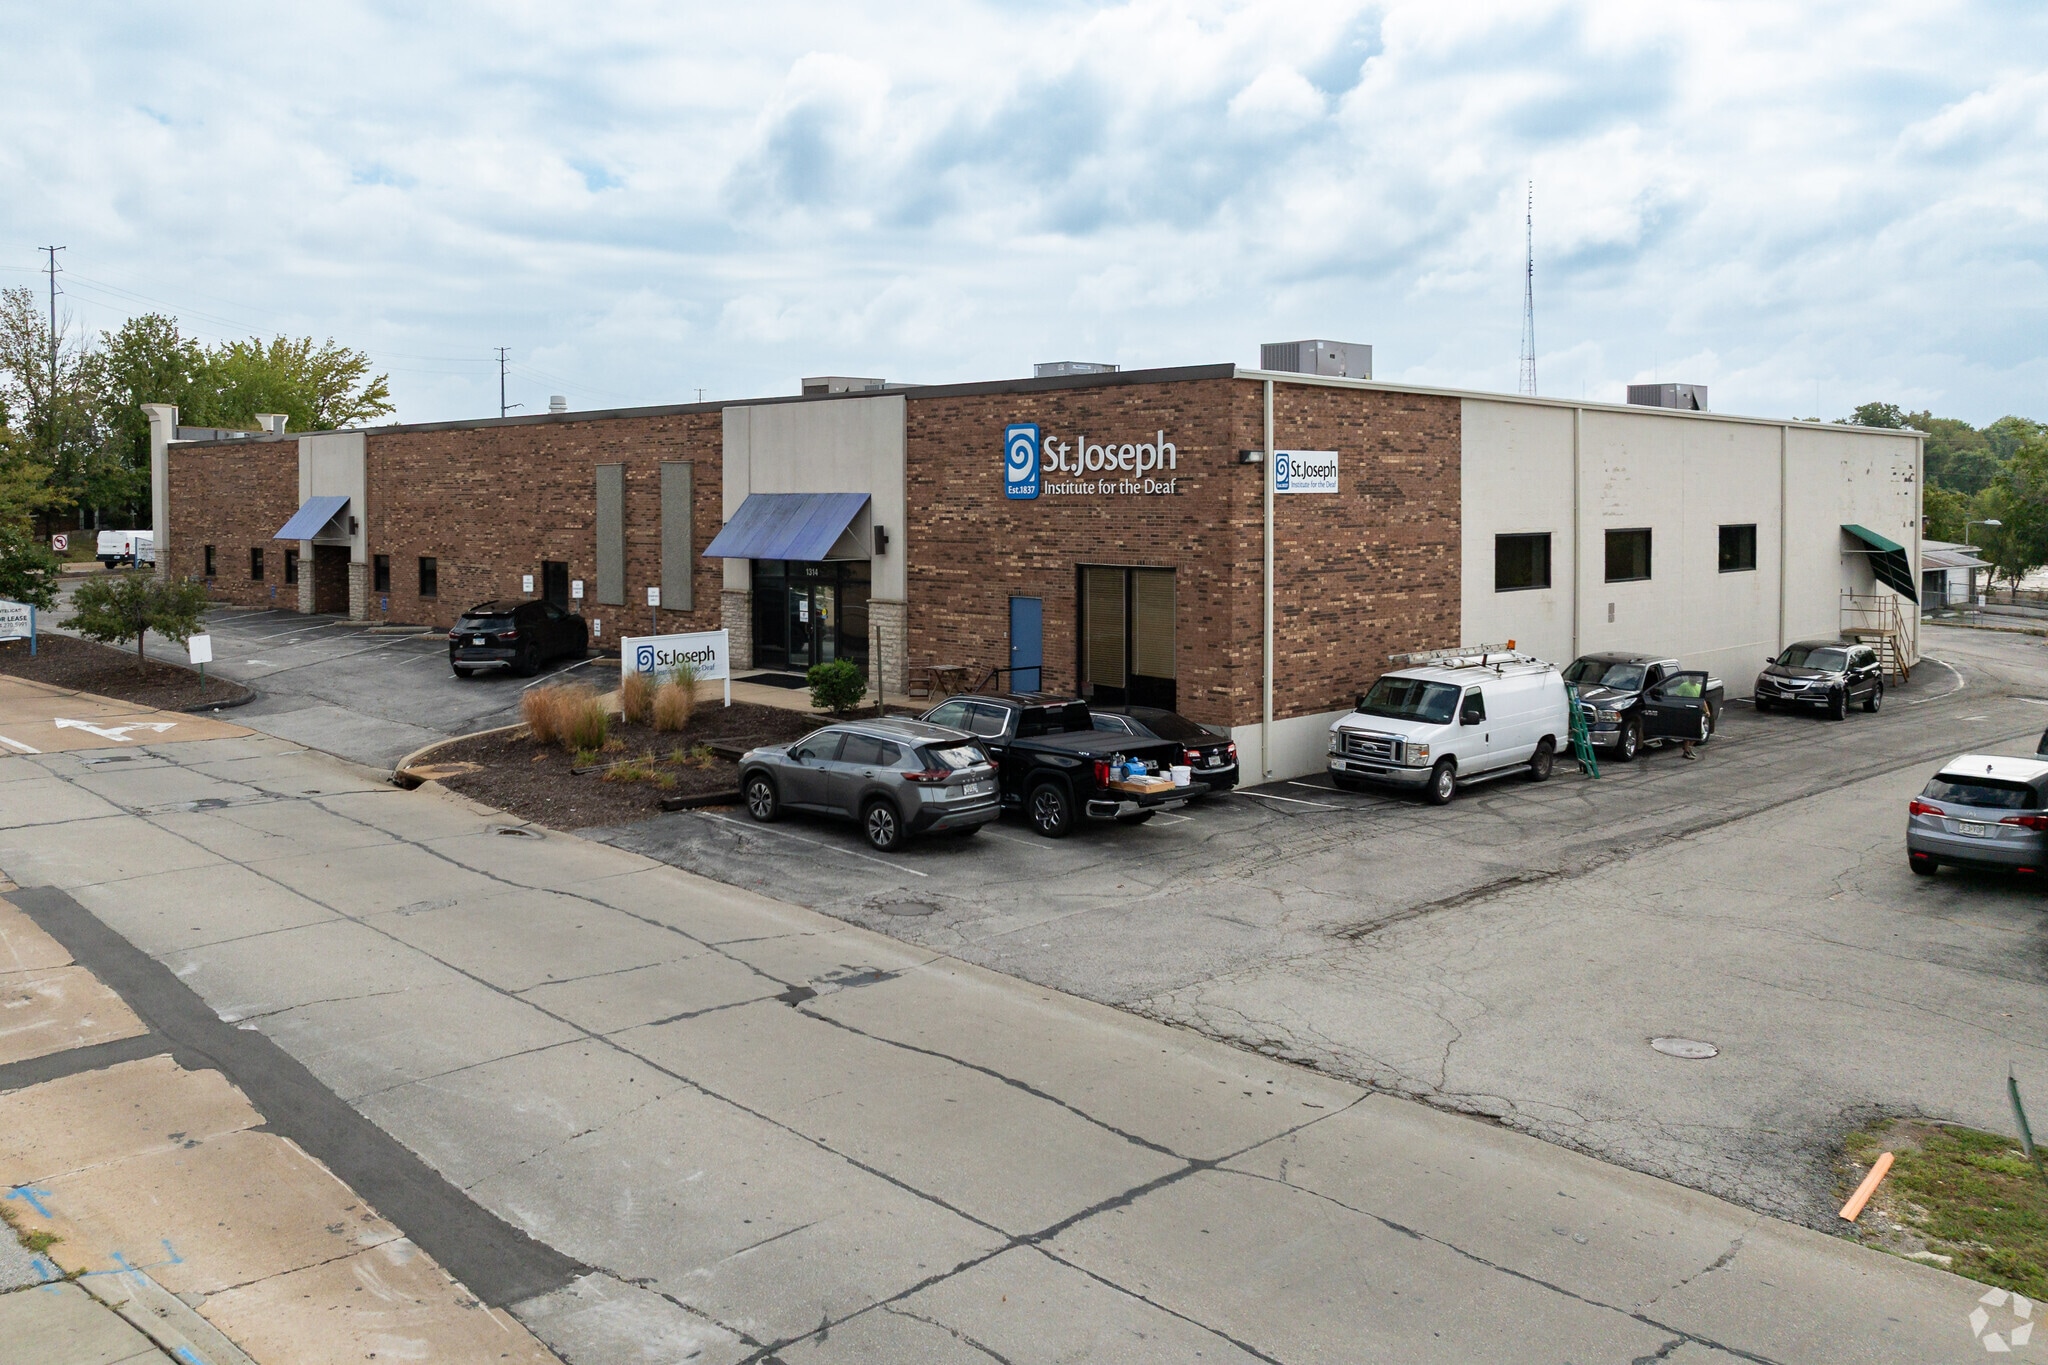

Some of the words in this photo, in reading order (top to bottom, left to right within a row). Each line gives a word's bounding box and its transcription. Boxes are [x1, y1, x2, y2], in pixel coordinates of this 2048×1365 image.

[1043, 430, 1177, 479] St.Joseph
[1291, 460, 1337, 480] St.Joseph
[1008, 485, 1035, 494] Est.1837
[1044, 479, 1095, 495] Institute
[1099, 479, 1116, 494] for
[1119, 479, 1140, 494] the
[1144, 478, 1177, 494] Deaf
[806, 568, 818, 576] 1314
[657, 645, 715, 667] St.Joseph
[701, 663, 715, 671] Deaf
